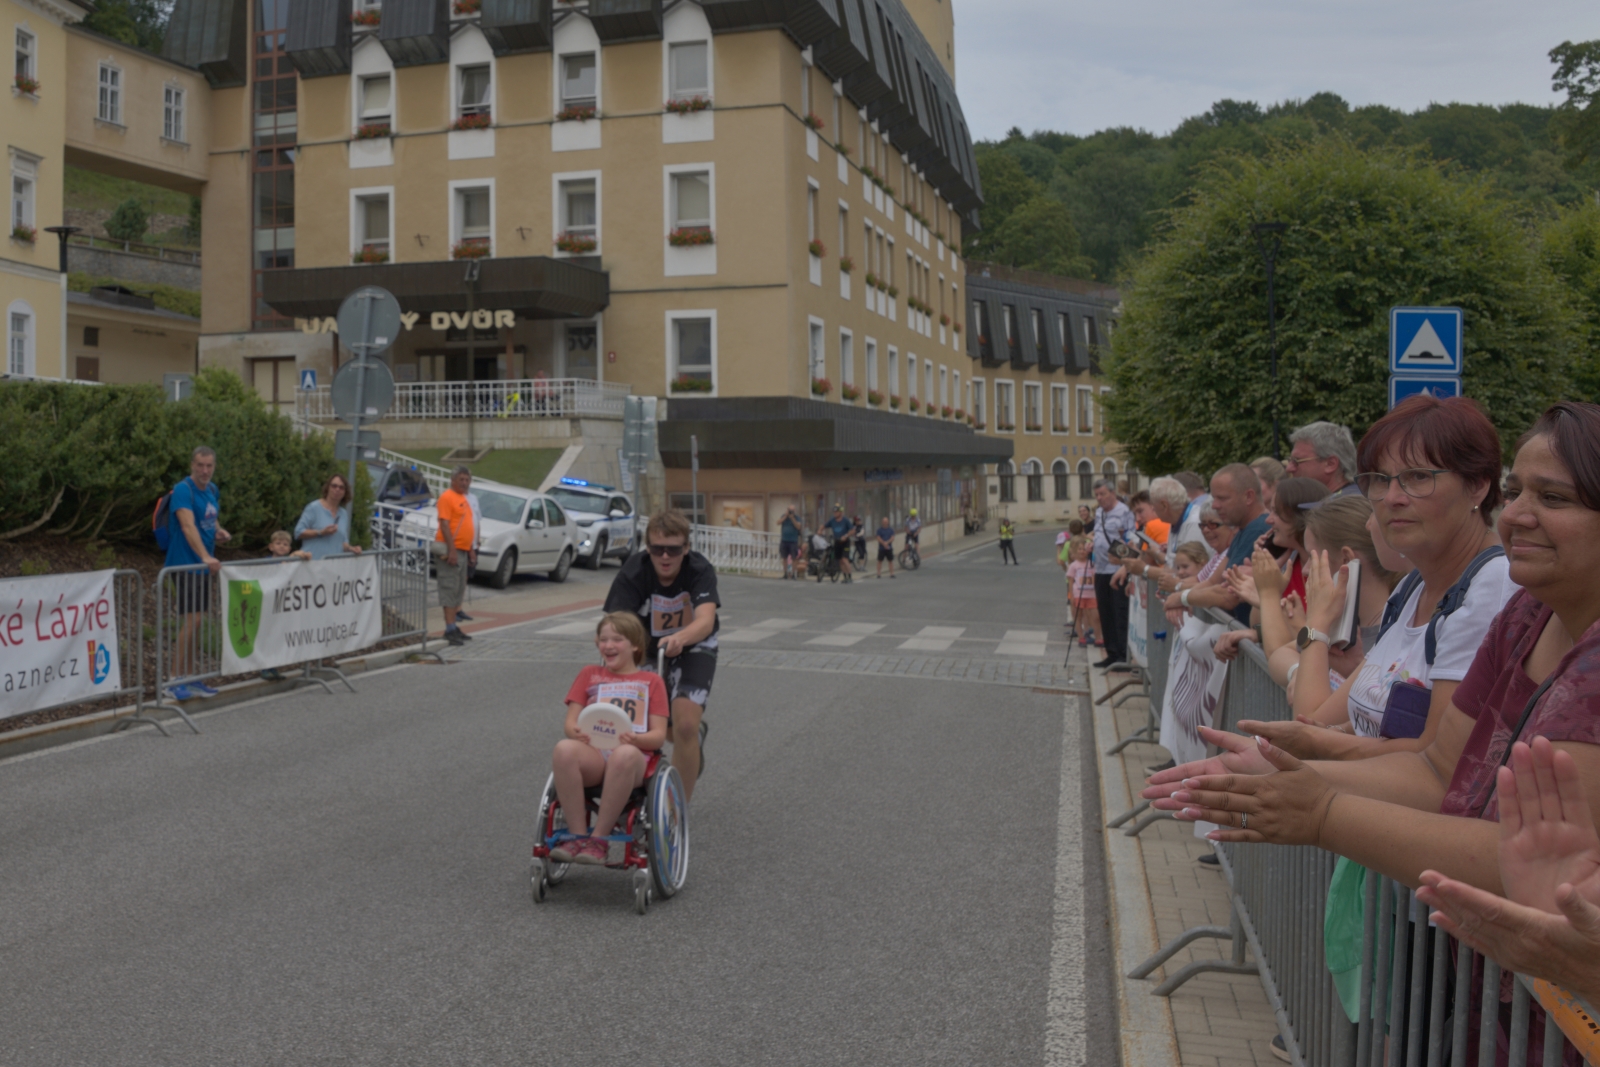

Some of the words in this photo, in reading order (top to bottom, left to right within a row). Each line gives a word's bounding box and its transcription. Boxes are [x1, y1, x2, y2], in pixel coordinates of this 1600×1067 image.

[431, 309, 515, 330] DVŮR
[332, 575, 374, 607] ÚPICE
[661, 610, 684, 630] 27
[593, 725, 616, 735] HLAS
